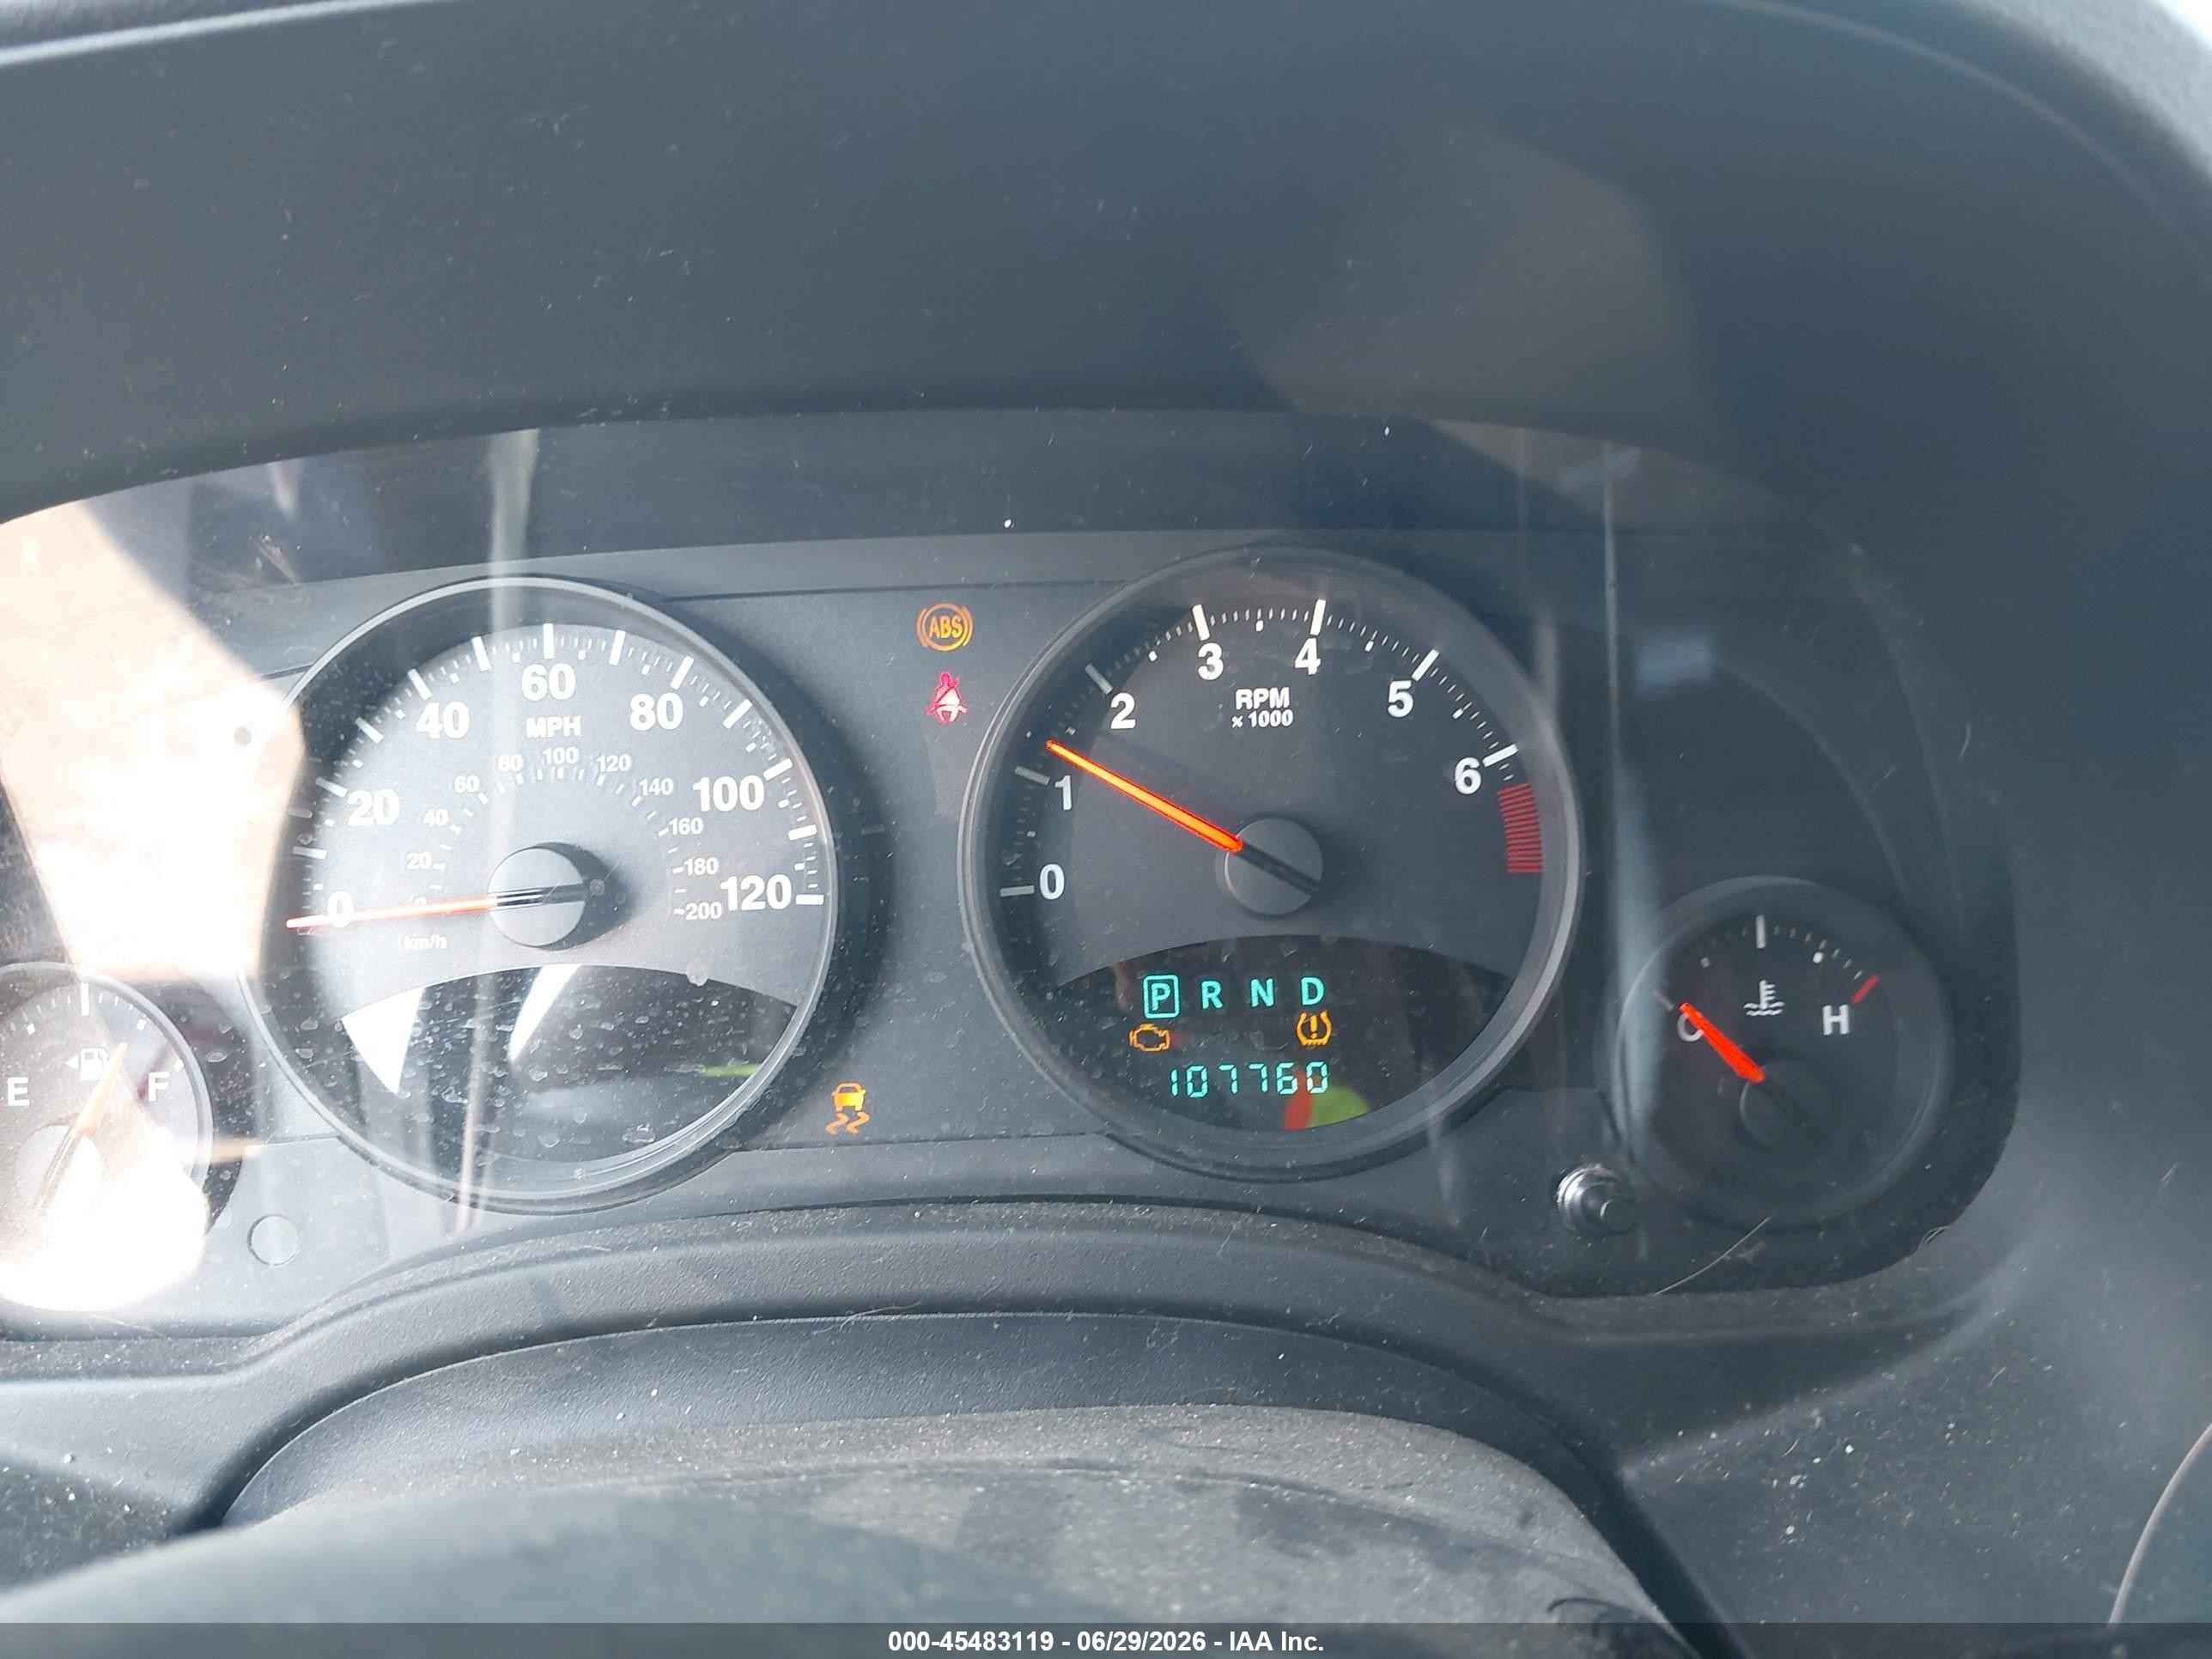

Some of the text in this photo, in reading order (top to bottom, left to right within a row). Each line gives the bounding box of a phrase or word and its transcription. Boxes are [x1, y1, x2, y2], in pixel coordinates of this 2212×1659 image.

[929, 615, 963, 639] ABS
[1198, 643, 1224, 680] 3
[1295, 639, 1321, 675] 4
[521, 663, 575, 701] 60
[629, 693, 683, 730] 80
[1110, 693, 1136, 728] 2
[1236, 687, 1290, 710] RPM
[1387, 680, 1413, 717] 5
[416, 701, 470, 739] 40
[526, 715, 581, 738] MPH
[1248, 709, 1293, 727] 1000
[498, 754, 523, 772] 80
[543, 747, 579, 766] 100
[597, 754, 632, 772] 120
[454, 775, 479, 793] 60
[639, 777, 673, 796] 140
[1455, 757, 1481, 794] 6
[348, 788, 399, 826] 20
[693, 775, 764, 811] 100
[1054, 775, 1073, 810] 1
[423, 809, 448, 828] 40
[669, 817, 703, 836] 160
[406, 852, 432, 870] 20
[684, 857, 719, 875] 180
[720, 874, 792, 911] 120
[1039, 864, 1065, 900] 0
[326, 891, 354, 927] 0
[685, 902, 722, 921] 200
[404, 933, 447, 951] km/h
[1151, 977, 1324, 1011] P R N D
[1822, 1004, 1850, 1035] H
[7, 1077, 30, 1107] E
[148, 1071, 170, 1102] F
[1170, 1060, 1328, 1097] 107760
